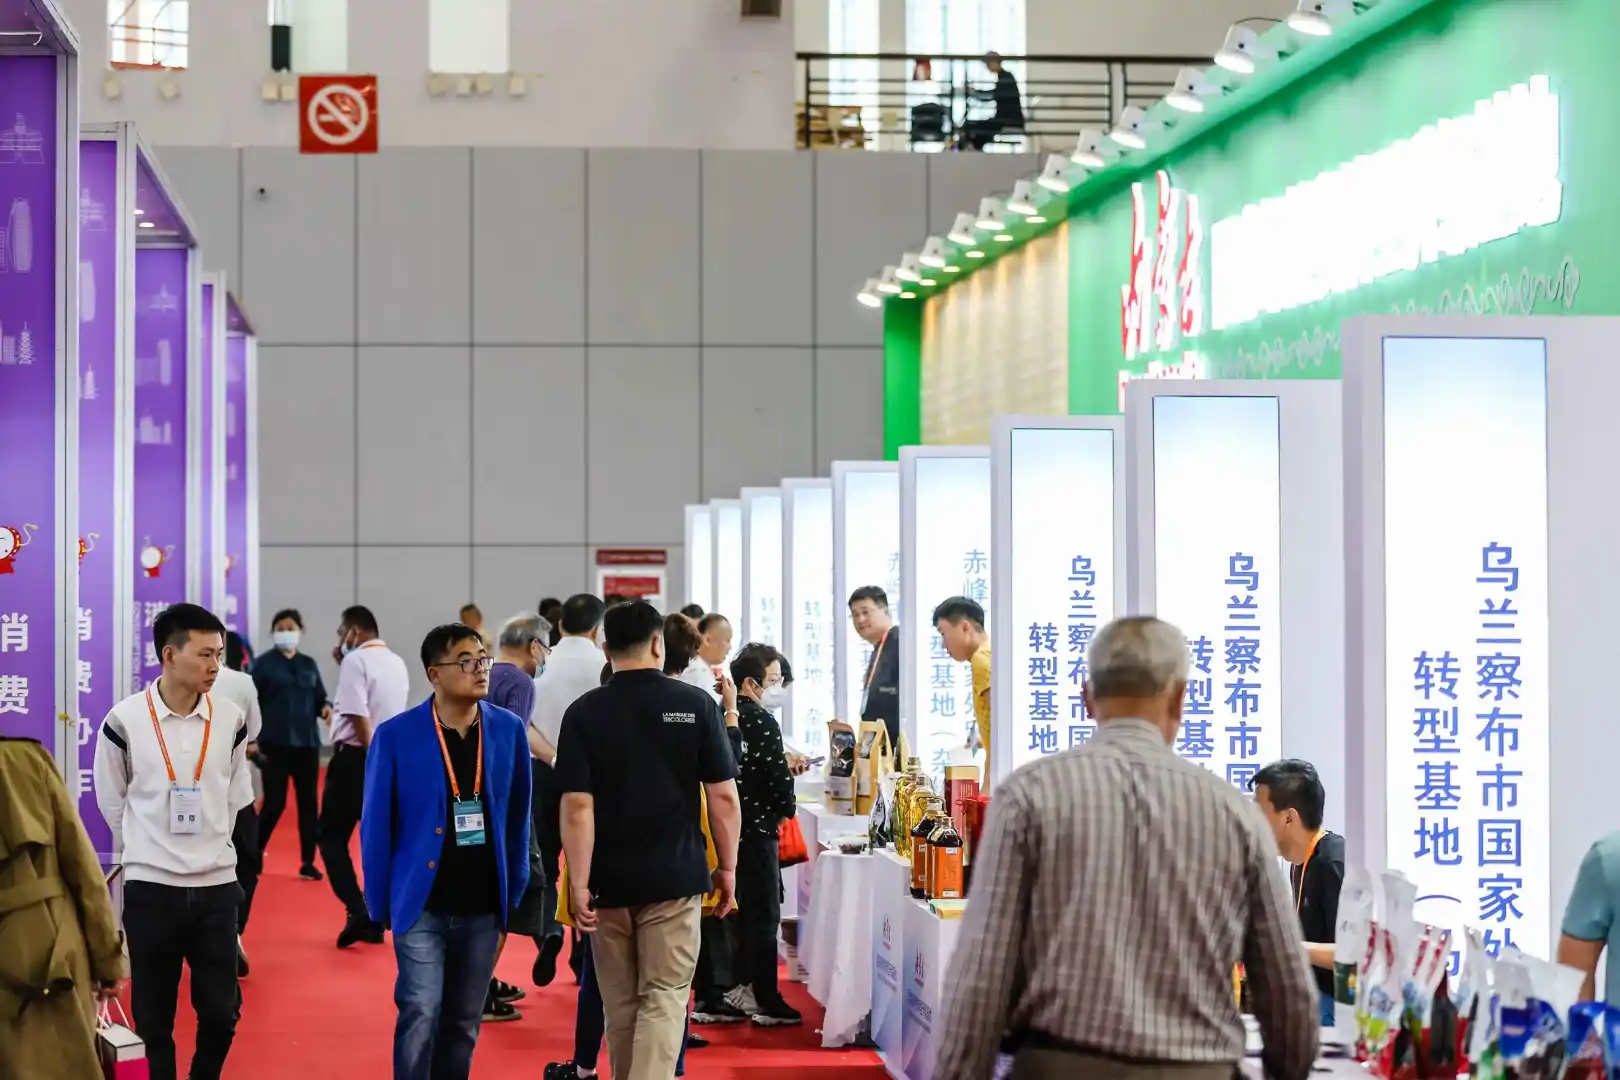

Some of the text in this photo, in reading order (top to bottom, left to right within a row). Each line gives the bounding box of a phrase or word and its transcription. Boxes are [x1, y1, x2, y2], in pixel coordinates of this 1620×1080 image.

[964, 549, 988, 613] 赤峰
[1028, 622, 1060, 755] 转型基地
[1176, 635, 1215, 772] 转型基
[1224, 551, 1262, 793] 乌兰察布市国
